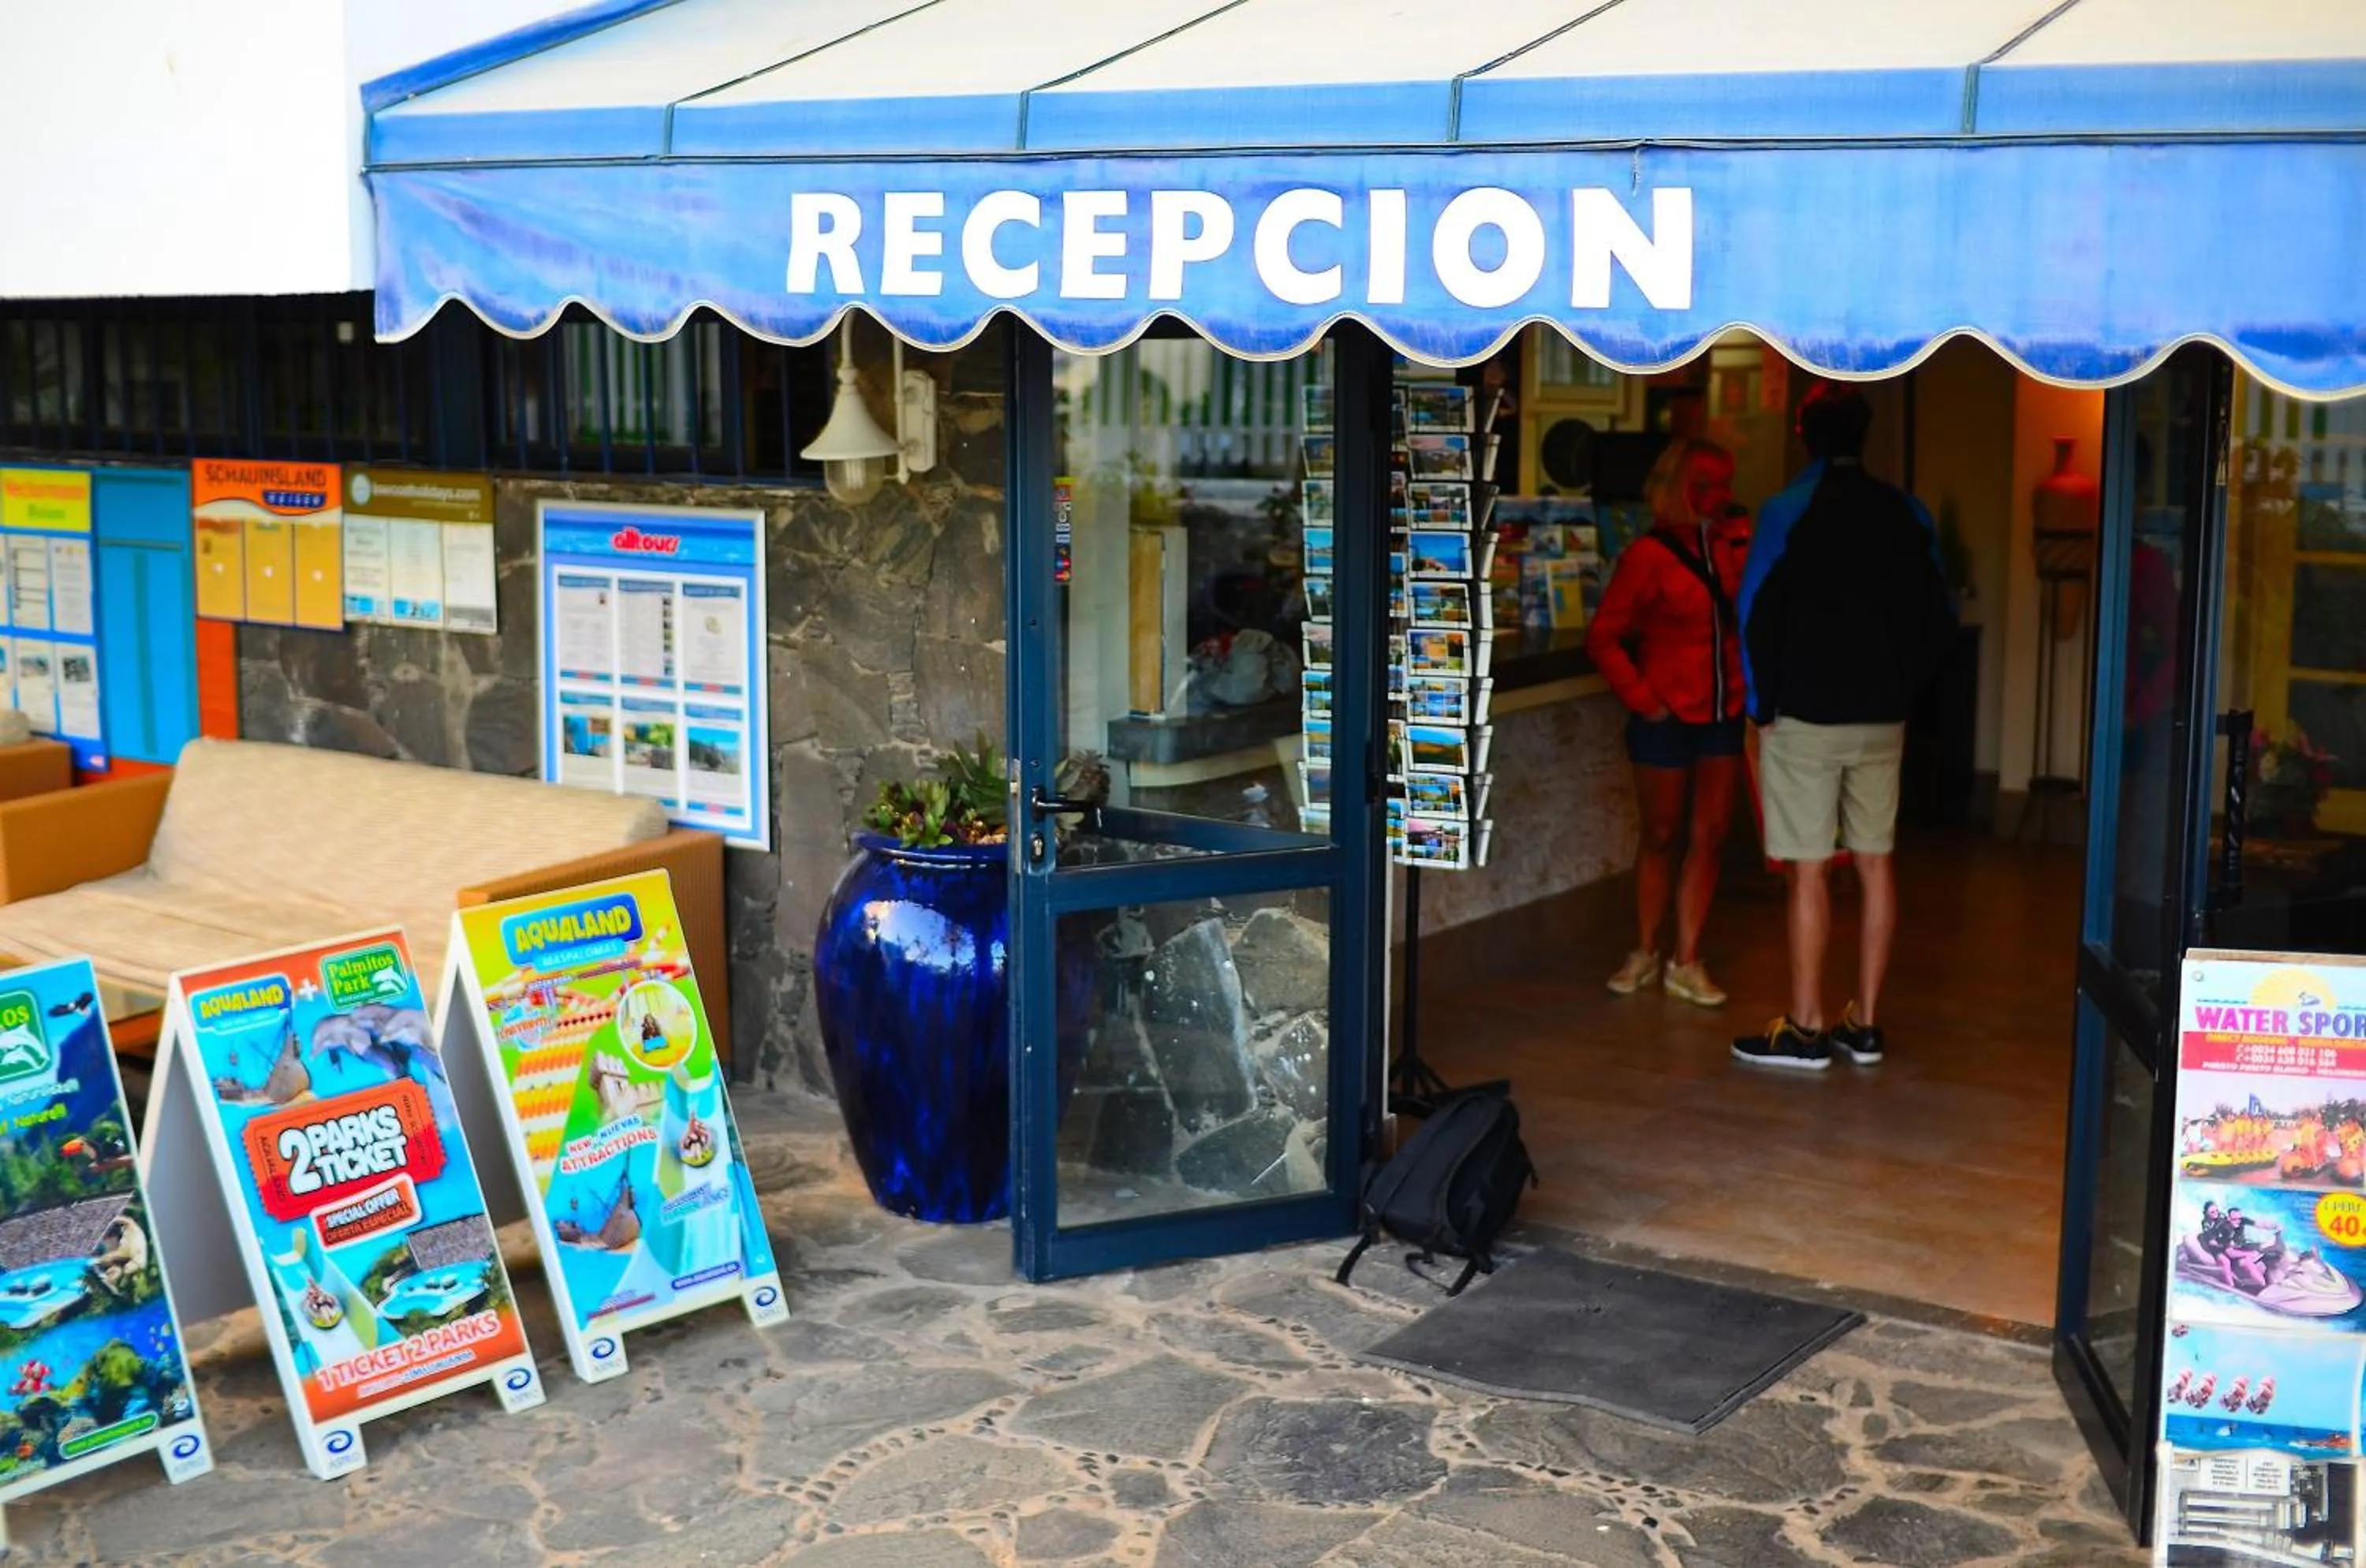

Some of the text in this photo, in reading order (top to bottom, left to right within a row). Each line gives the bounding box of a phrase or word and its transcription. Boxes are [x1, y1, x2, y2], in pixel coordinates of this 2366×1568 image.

[786, 186, 1693, 309] RECEPCION
[515, 905, 631, 952] AQUALAND
[327, 953, 394, 978] Palmitos
[334, 975, 370, 995] Park
[200, 984, 284, 1019] AQUALAND
[2195, 1006, 2289, 1033] WATER
[278, 1127, 323, 1195] 2
[305, 1104, 402, 1157] PARKS
[314, 1135, 408, 1185] TICKET
[562, 1129, 657, 1171] ATTRACTIONS
[333, 1342, 406, 1383] TICKET
[410, 1338, 425, 1358] 2
[428, 1312, 498, 1350] PARKS
